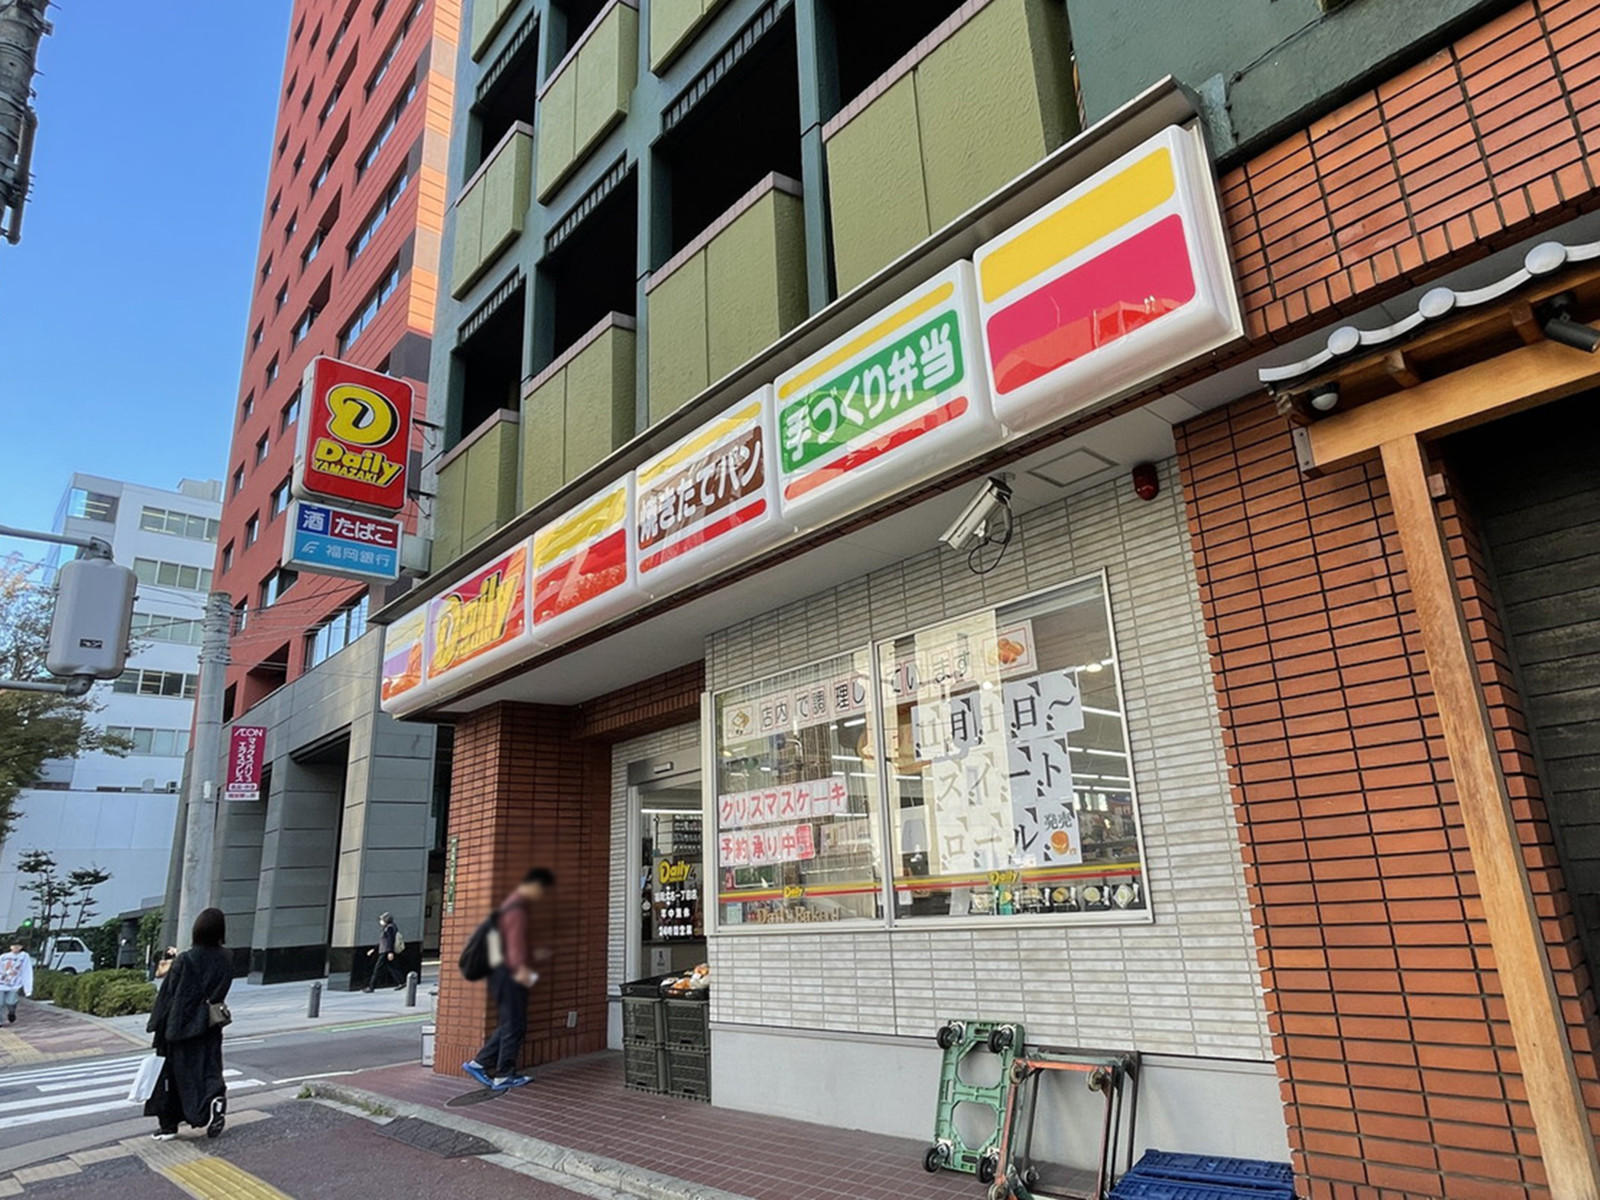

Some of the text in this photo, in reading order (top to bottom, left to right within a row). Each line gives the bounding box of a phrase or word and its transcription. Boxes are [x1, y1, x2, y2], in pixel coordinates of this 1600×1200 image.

[786, 322, 956, 463] 手づくり弁当
[313, 438, 404, 487] Daily
[313, 459, 378, 484] YAMAZAKI
[638, 440, 762, 544] 焼きたてパン
[302, 510, 394, 545] 酒 たばこ
[325, 544, 391, 569] 福岡銀行
[434, 569, 520, 669] Daily
[721, 782, 847, 822] クリスマスケーキ
[1043, 812, 1073, 831] 発売
[721, 833, 796, 861] 予約承り中
[658, 860, 691, 884] Daily
[988, 870, 1019, 885] Daily
